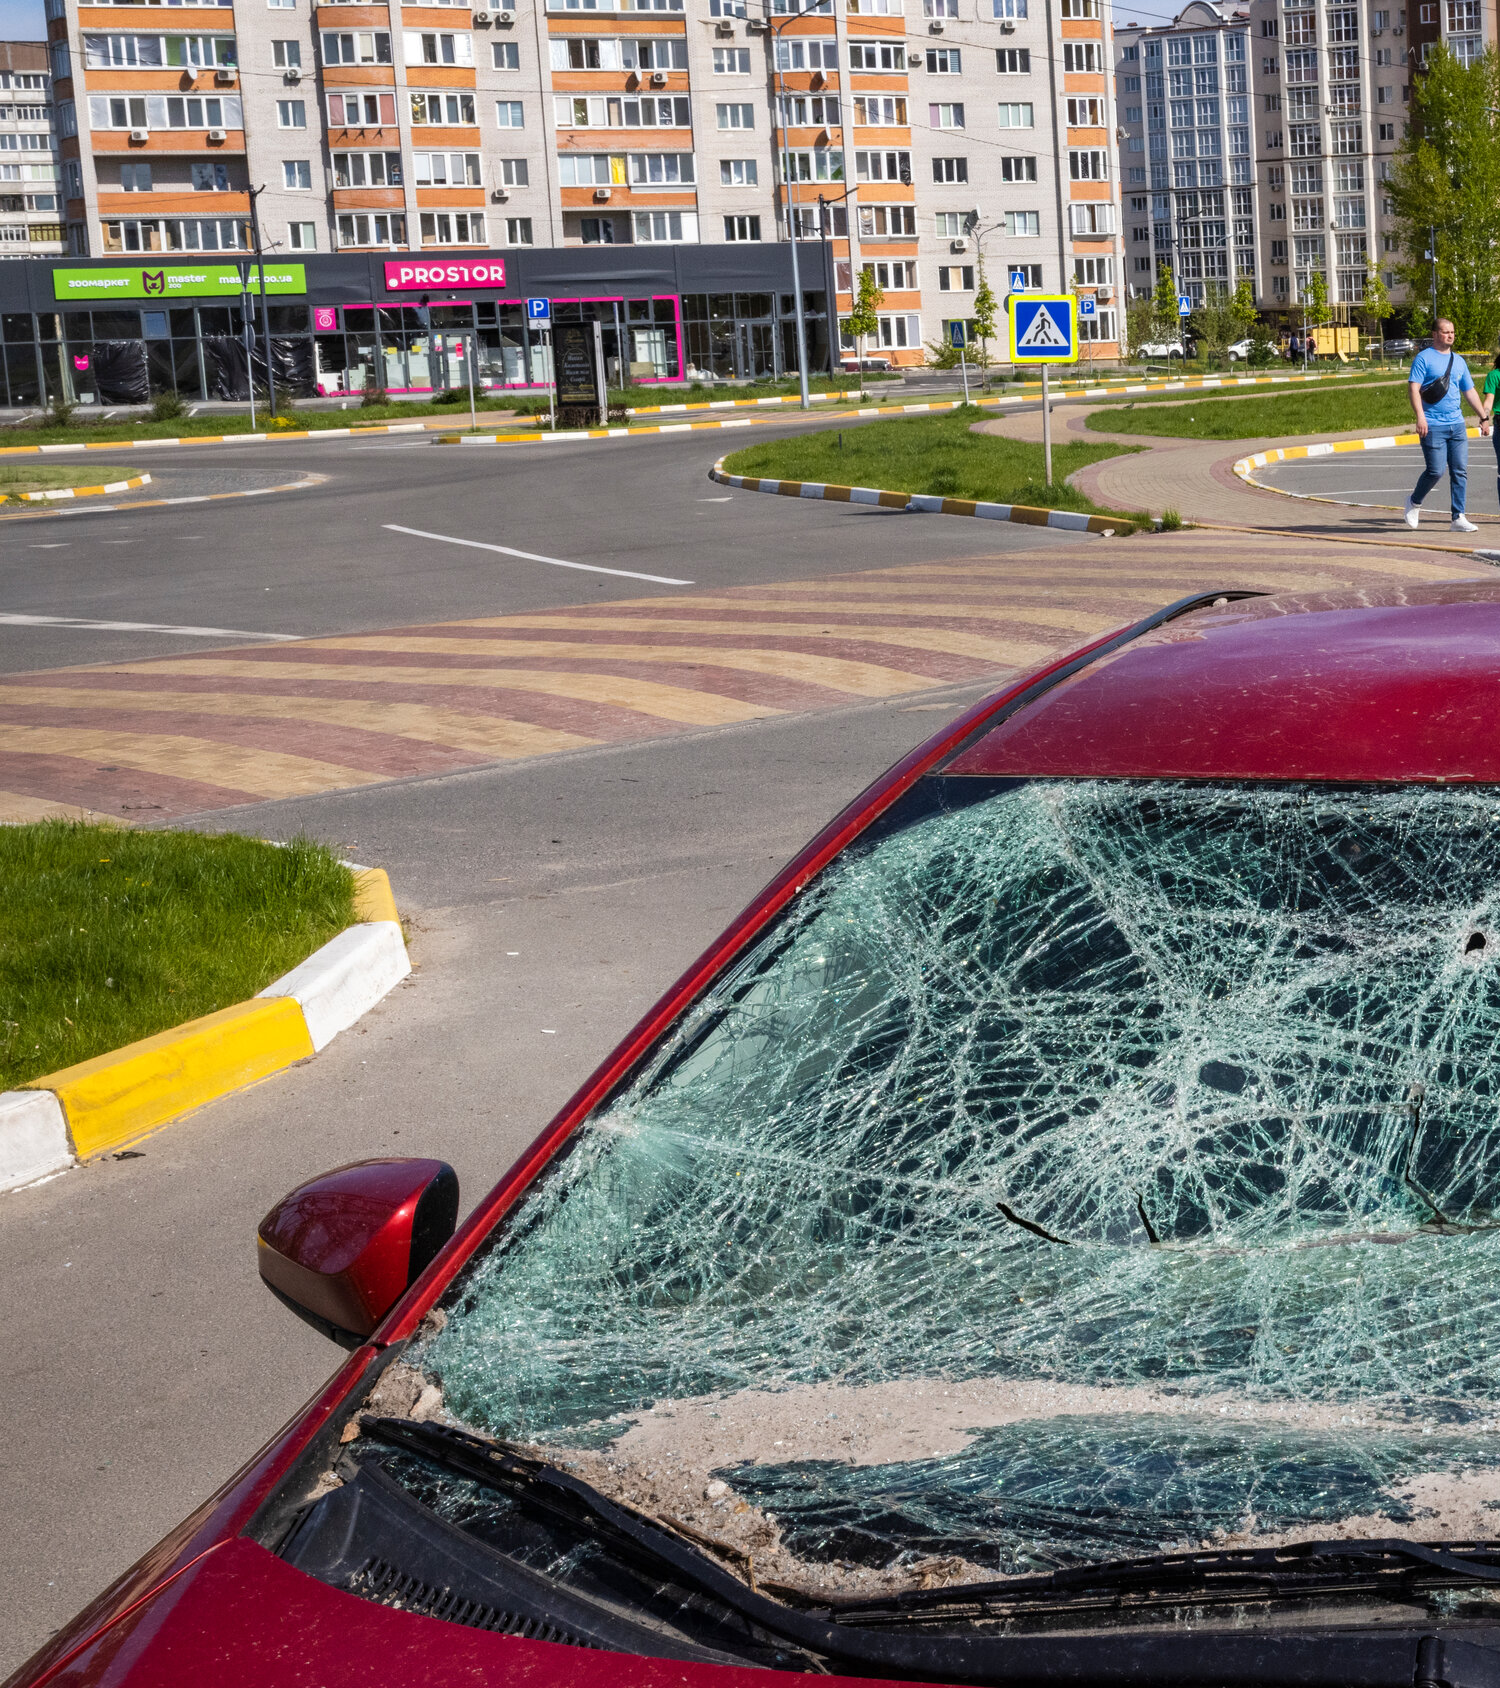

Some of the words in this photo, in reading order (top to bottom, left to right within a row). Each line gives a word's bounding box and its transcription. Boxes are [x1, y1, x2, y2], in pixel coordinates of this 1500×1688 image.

[167, 274, 207, 283] master
[218, 275, 293, 284] maseroo.ua
[400, 266, 504, 284] PROSTOR
[68, 279, 130, 289] зоомаркет
[533, 300, 544, 316] P
[1084, 302, 1092, 313] P
